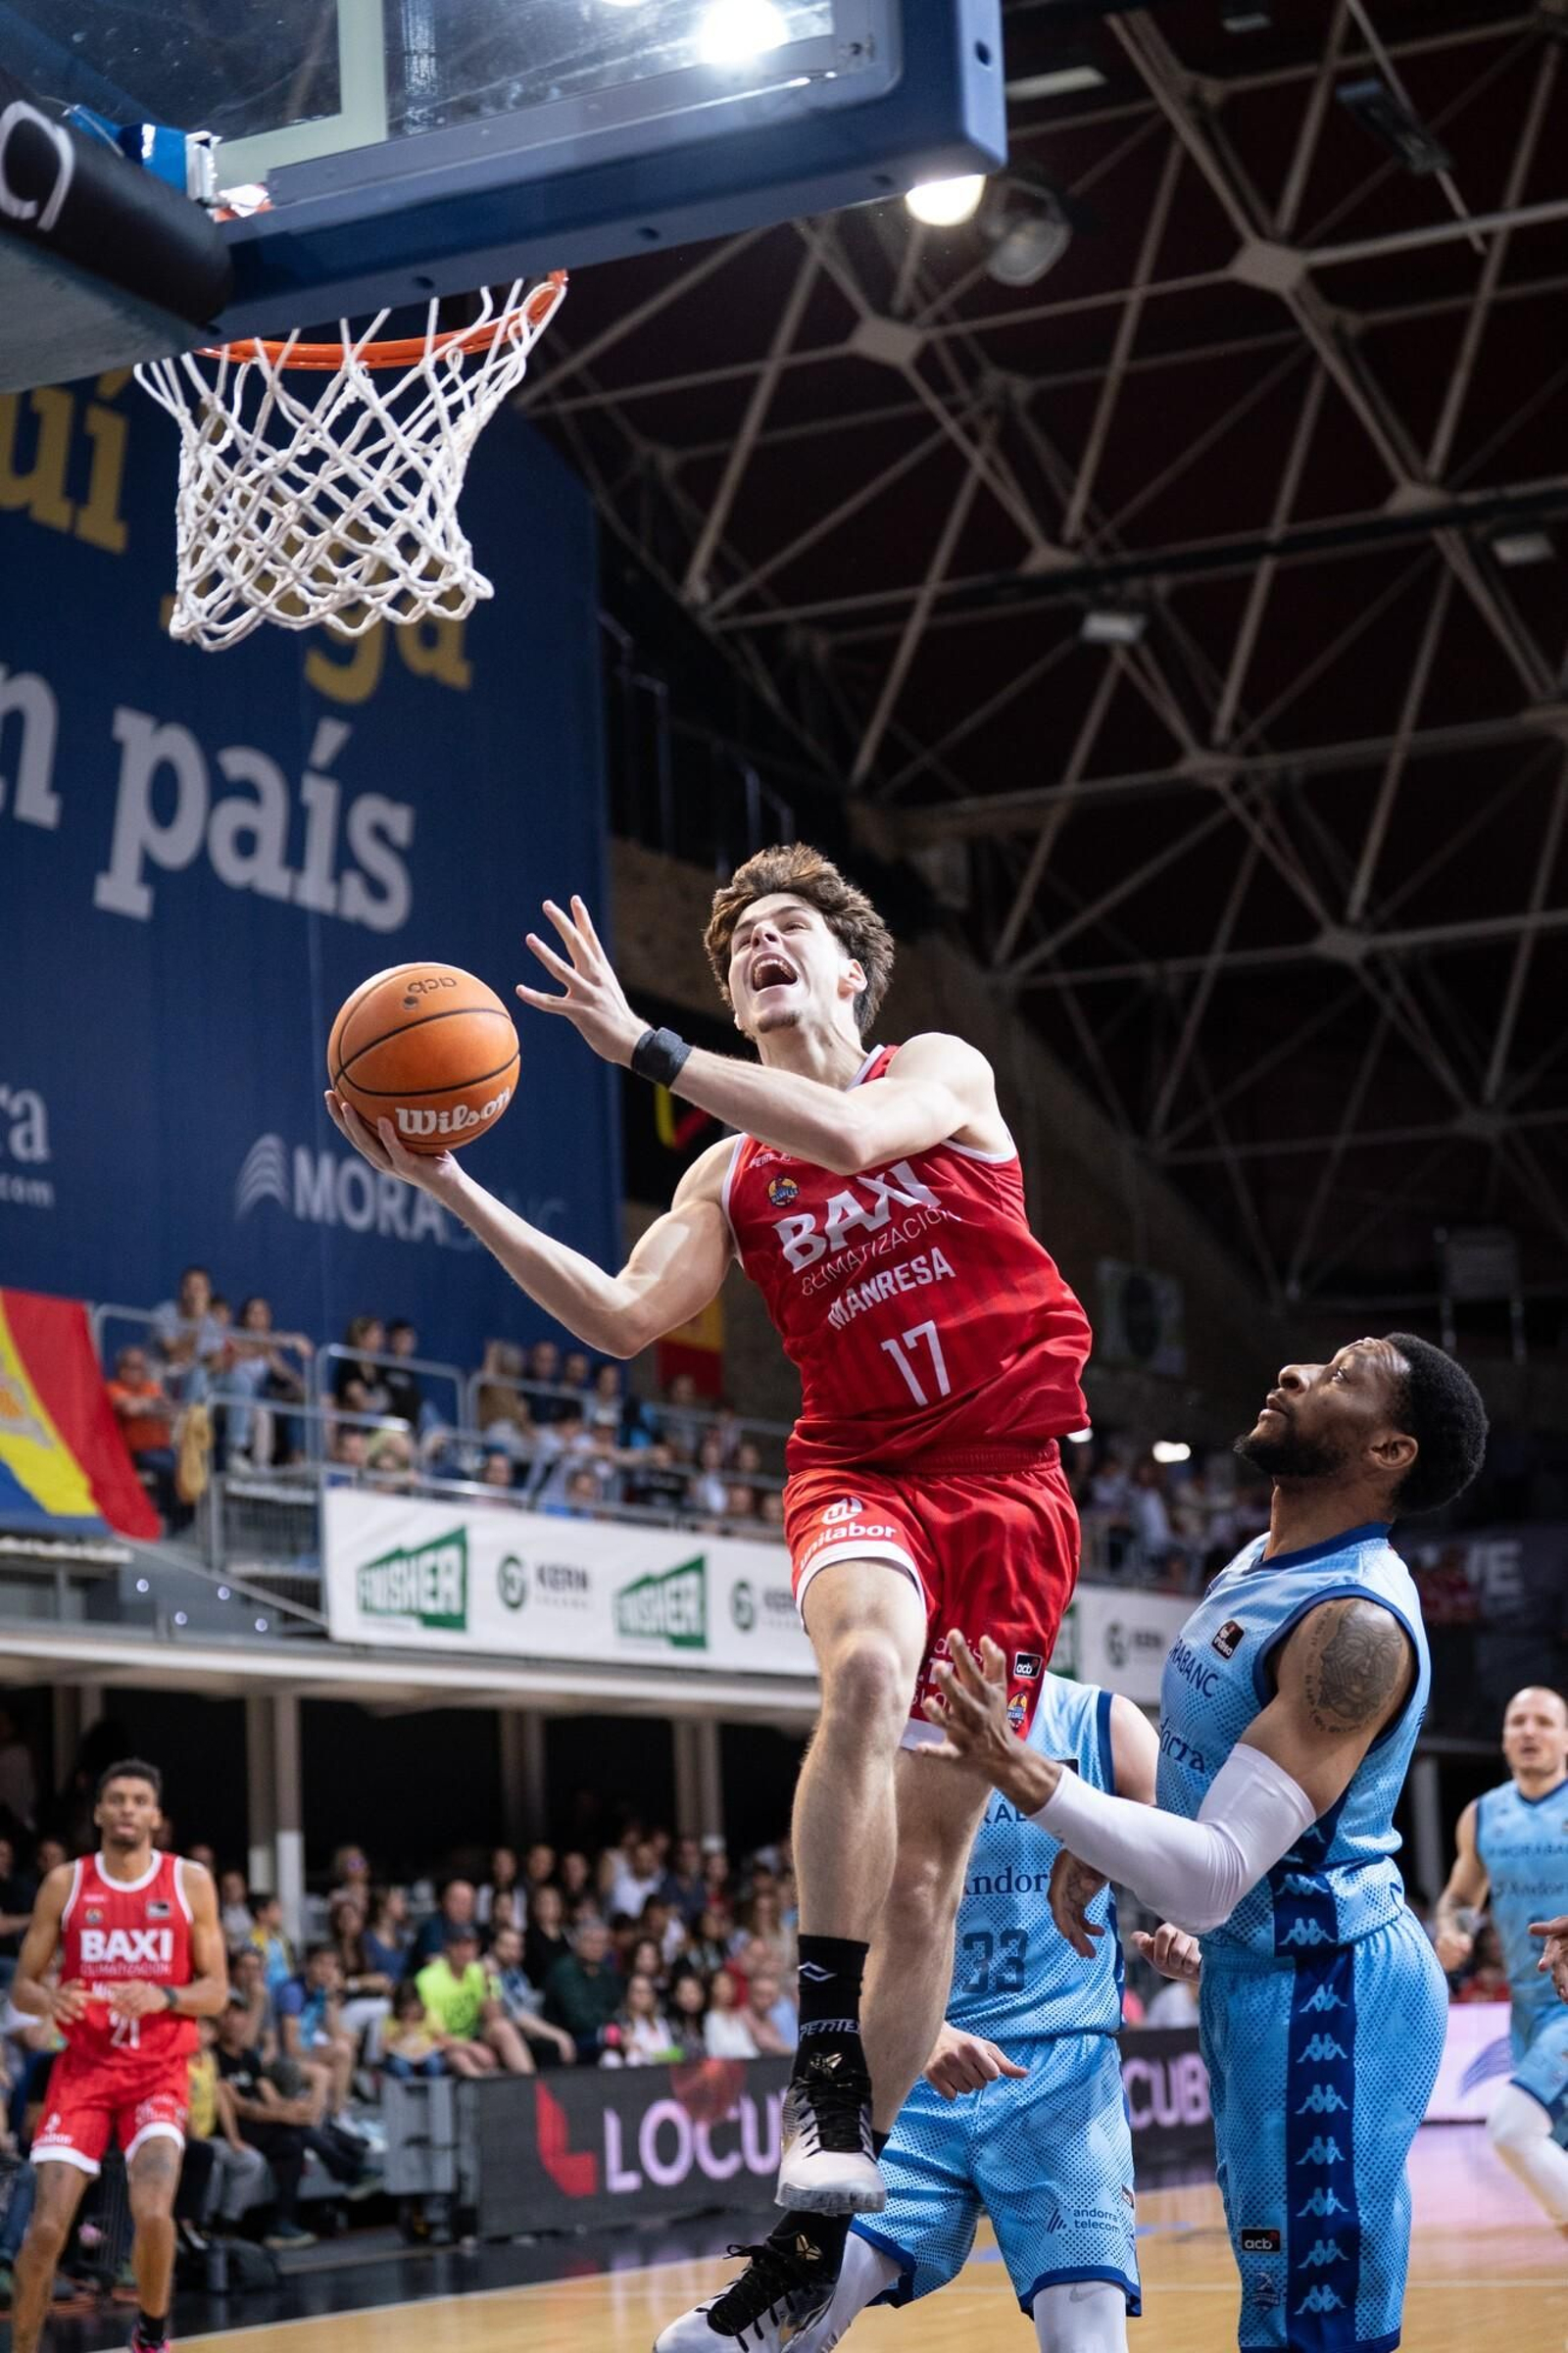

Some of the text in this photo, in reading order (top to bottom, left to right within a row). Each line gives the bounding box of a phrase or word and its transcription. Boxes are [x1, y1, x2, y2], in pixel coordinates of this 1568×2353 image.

[93, 706, 415, 934] país
[0, 1083, 51, 1163] a
[396, 1087, 511, 1135] Wilson
[772, 1159, 942, 1274] BAXI
[827, 1246, 957, 1331] MANRESA
[880, 1319, 952, 1407] 17
[1015, 1664, 1033, 1675] acb
[1168, 1638, 1218, 1699] RABANC
[79, 1928, 174, 1963] BAXI
[604, 2090, 783, 2194] LOCU
[1073, 2207, 1119, 2223] andorra
[1074, 2219, 1121, 2233] telecom
[1244, 2237, 1273, 2250] acb
